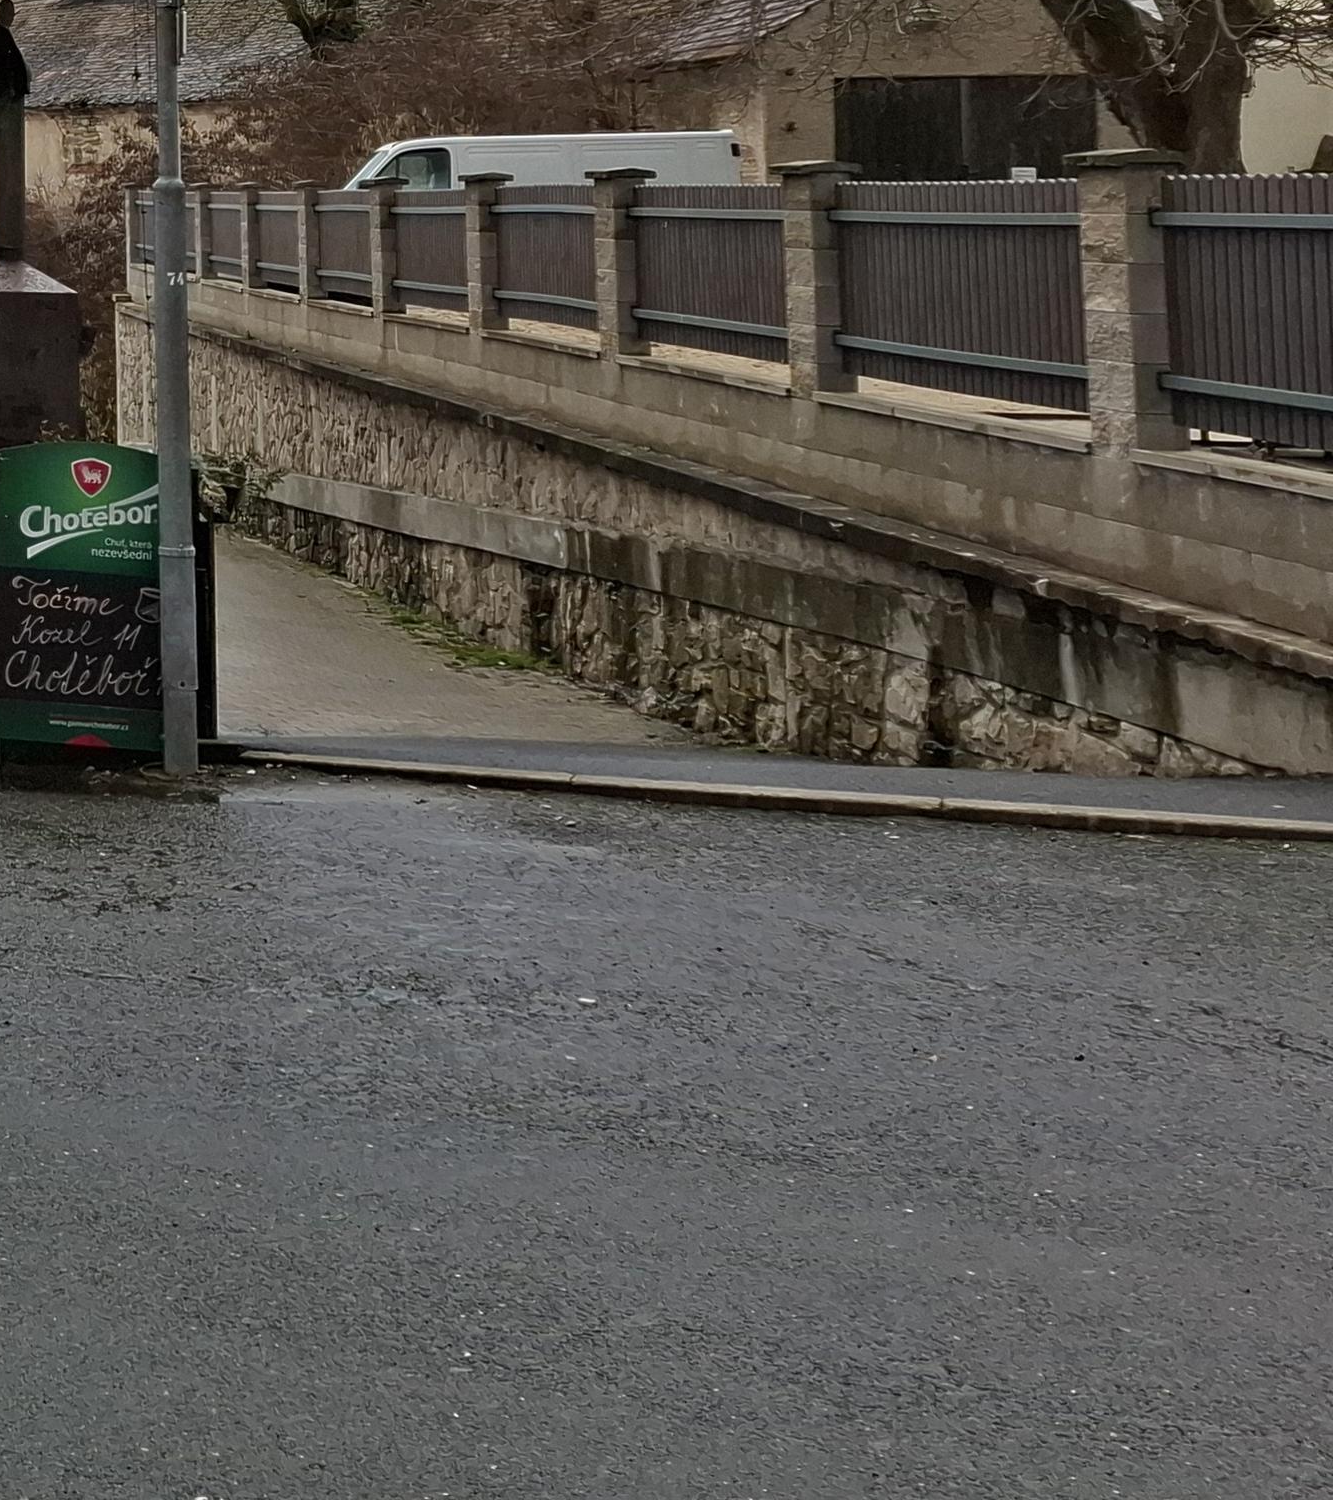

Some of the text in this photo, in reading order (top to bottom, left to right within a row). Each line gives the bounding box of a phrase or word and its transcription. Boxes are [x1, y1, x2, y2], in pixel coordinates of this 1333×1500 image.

[19, 503, 158, 538] Chotebor
[91, 548, 153, 561] nezevšední
[11, 575, 124, 616] Točíme
[11, 614, 142, 651] Kozel 11
